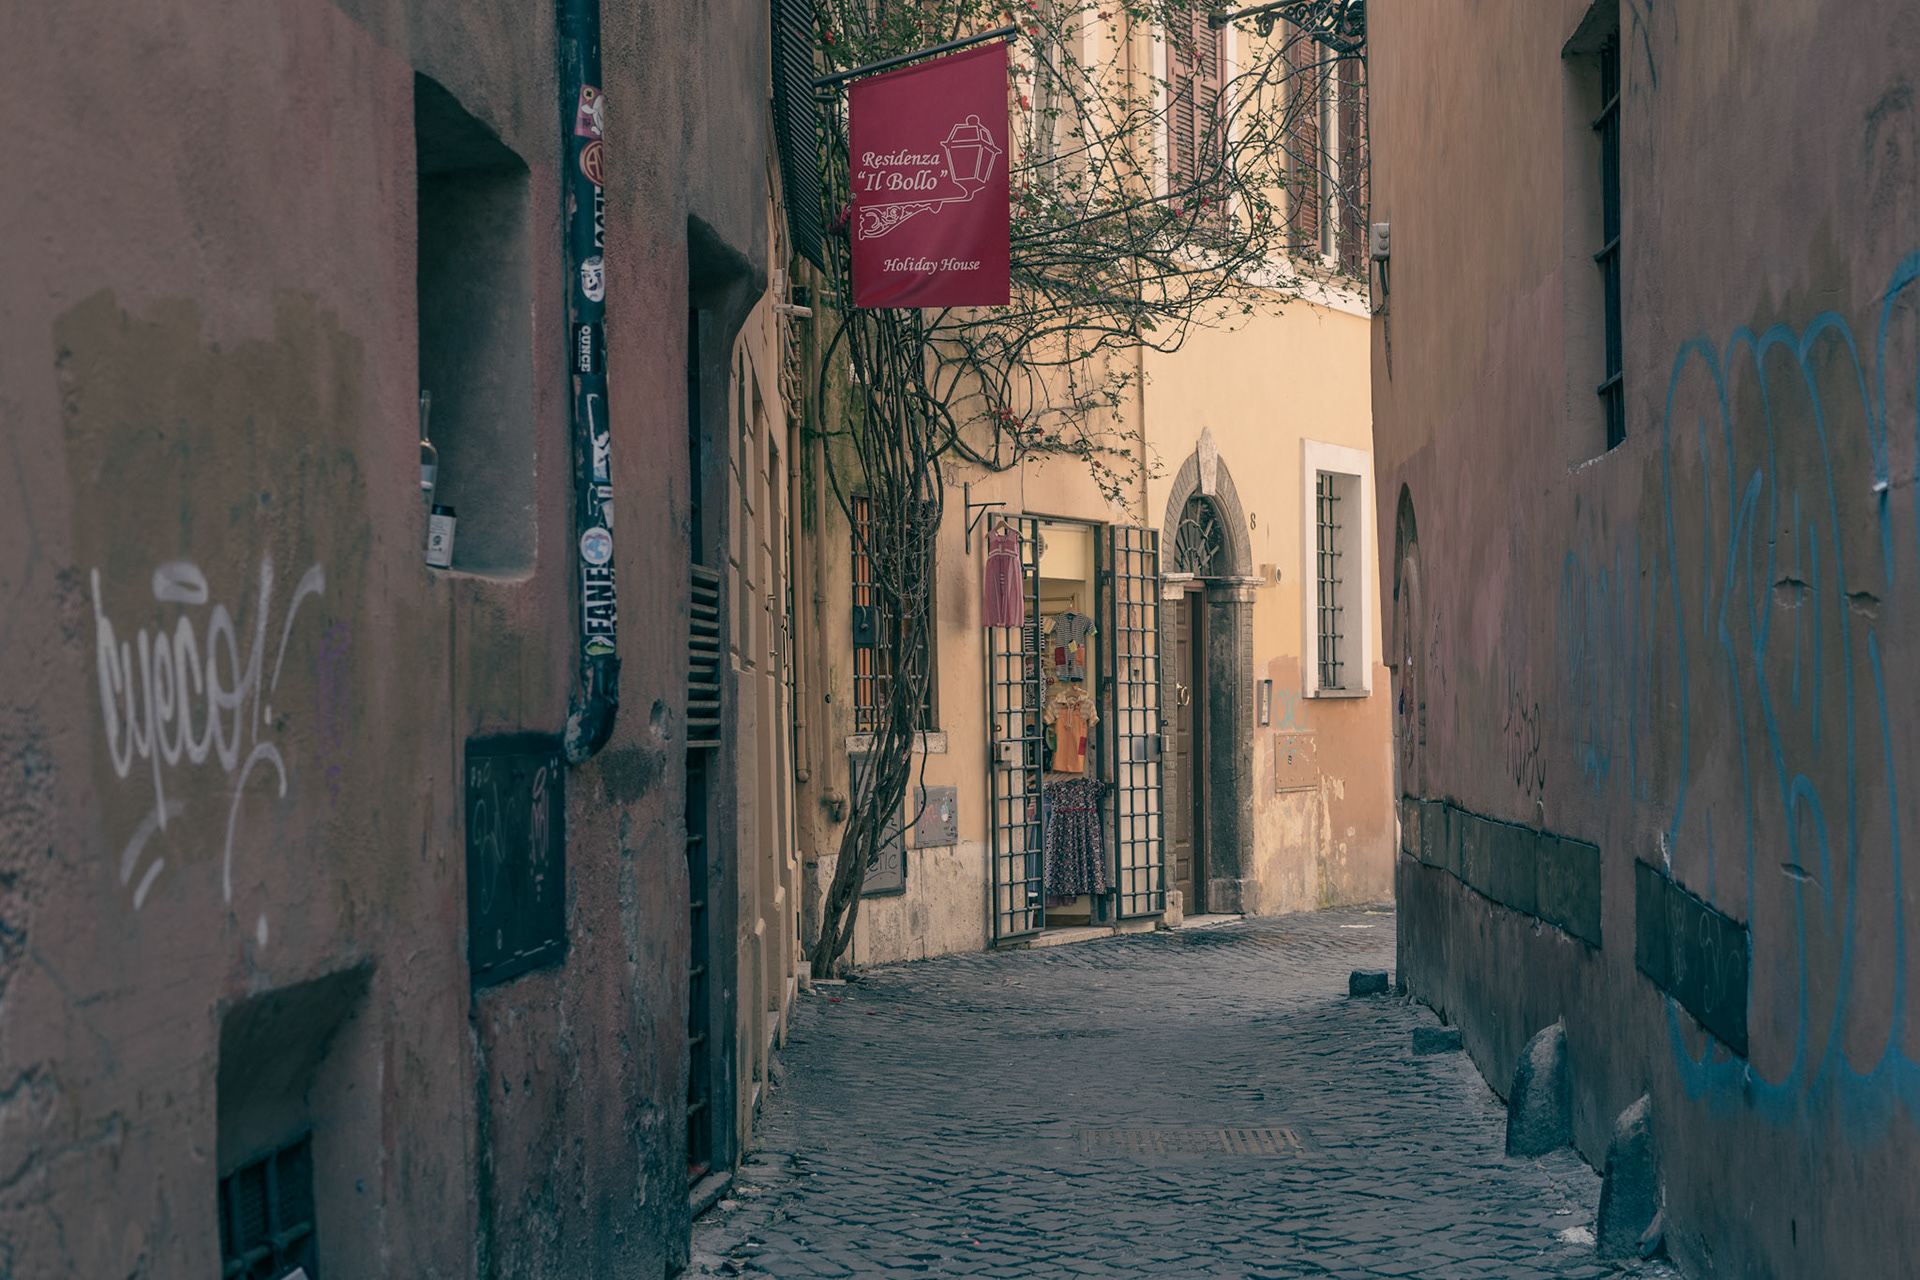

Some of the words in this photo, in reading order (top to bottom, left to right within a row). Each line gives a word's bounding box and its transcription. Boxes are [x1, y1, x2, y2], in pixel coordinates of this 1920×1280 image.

[862, 149, 940, 168] Residenza
[883, 257, 938, 274] Holiday
[940, 258, 980, 271] House
[581, 325, 591, 372] OUNCE
[1250, 511, 1257, 531] 8
